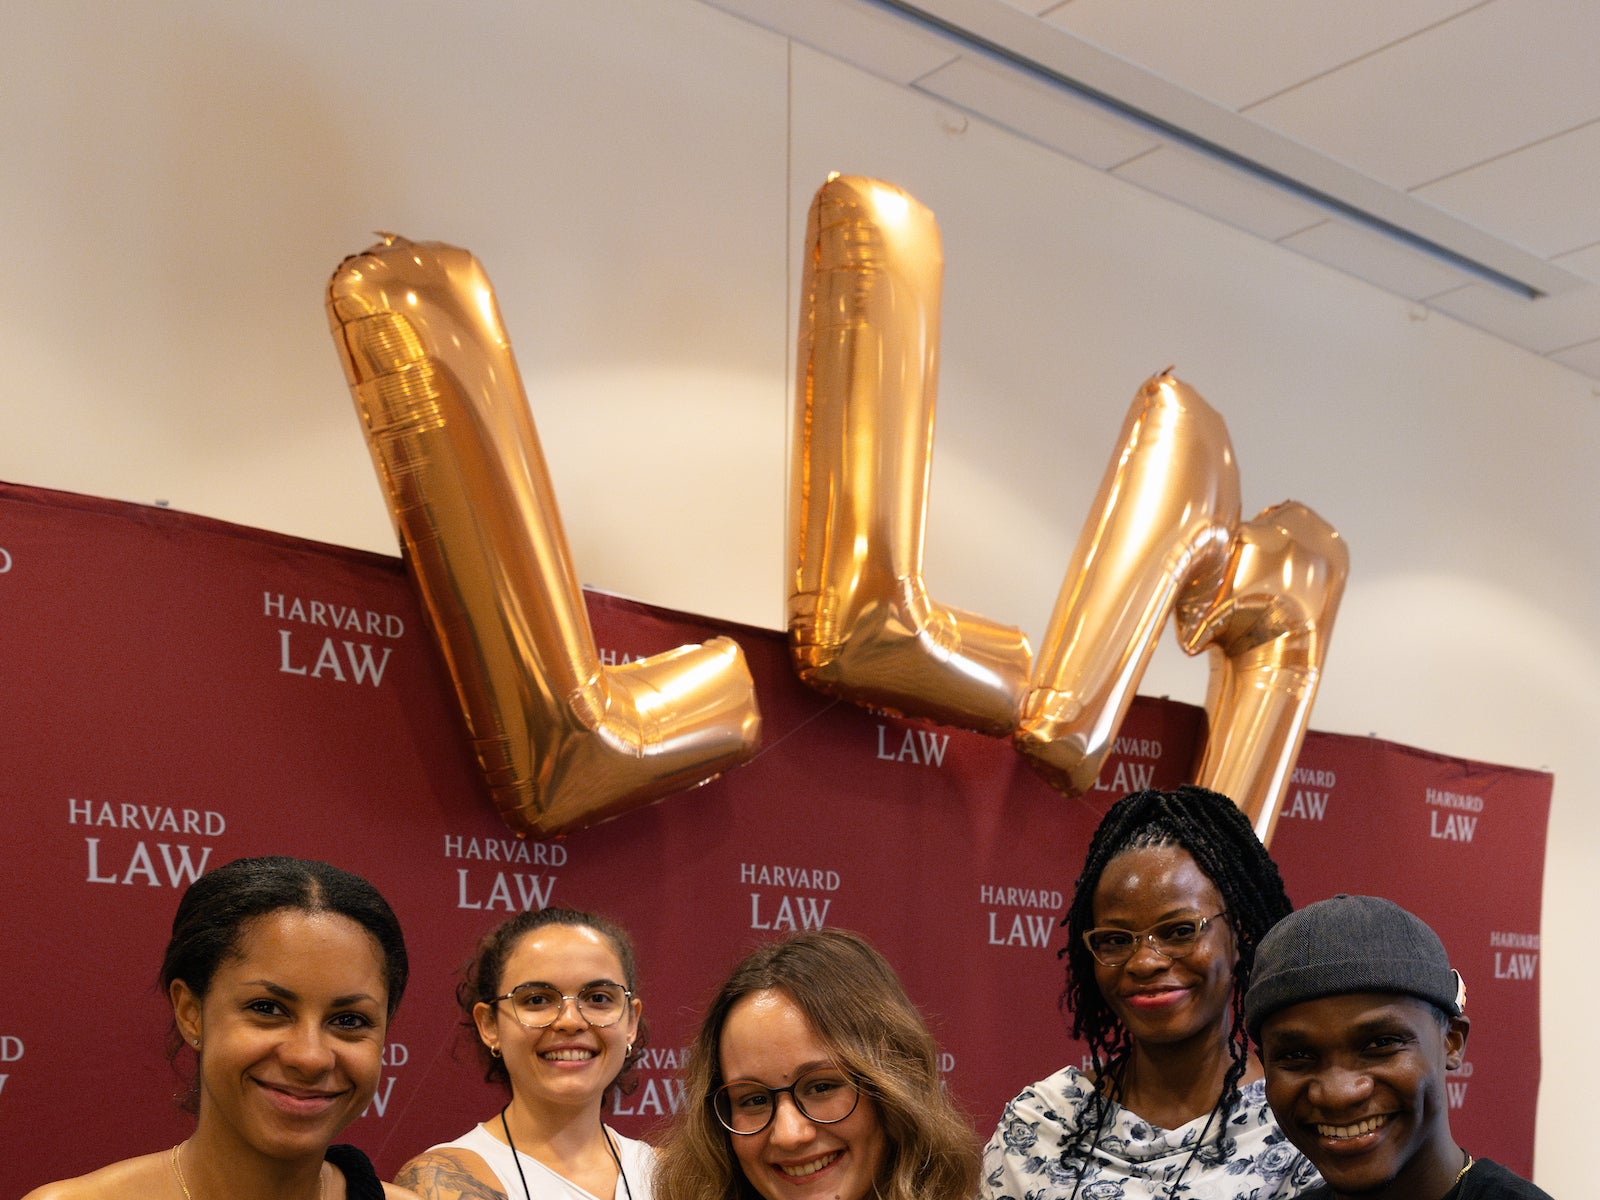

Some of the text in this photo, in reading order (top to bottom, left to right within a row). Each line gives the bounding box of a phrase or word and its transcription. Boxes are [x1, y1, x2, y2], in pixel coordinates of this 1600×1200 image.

[263, 591, 404, 639] HARVARD
[278, 629, 393, 688] LAW
[877, 724, 950, 768] LAW
[1112, 737, 1162, 759] RVARD
[1291, 767, 1337, 788] RVARD
[68, 798, 226, 836] HARVARD
[1425, 787, 1484, 813] HARVARD
[1430, 810, 1478, 843] LAW
[85, 837, 213, 889] LAW
[444, 834, 568, 867] HARVARD
[457, 868, 558, 912] LAW
[740, 863, 841, 891] HARVARD
[750, 893, 832, 932] LAW
[980, 884, 1063, 910] HARVARD
[988, 912, 1056, 949] LAW
[1494, 952, 1538, 980] LAW
